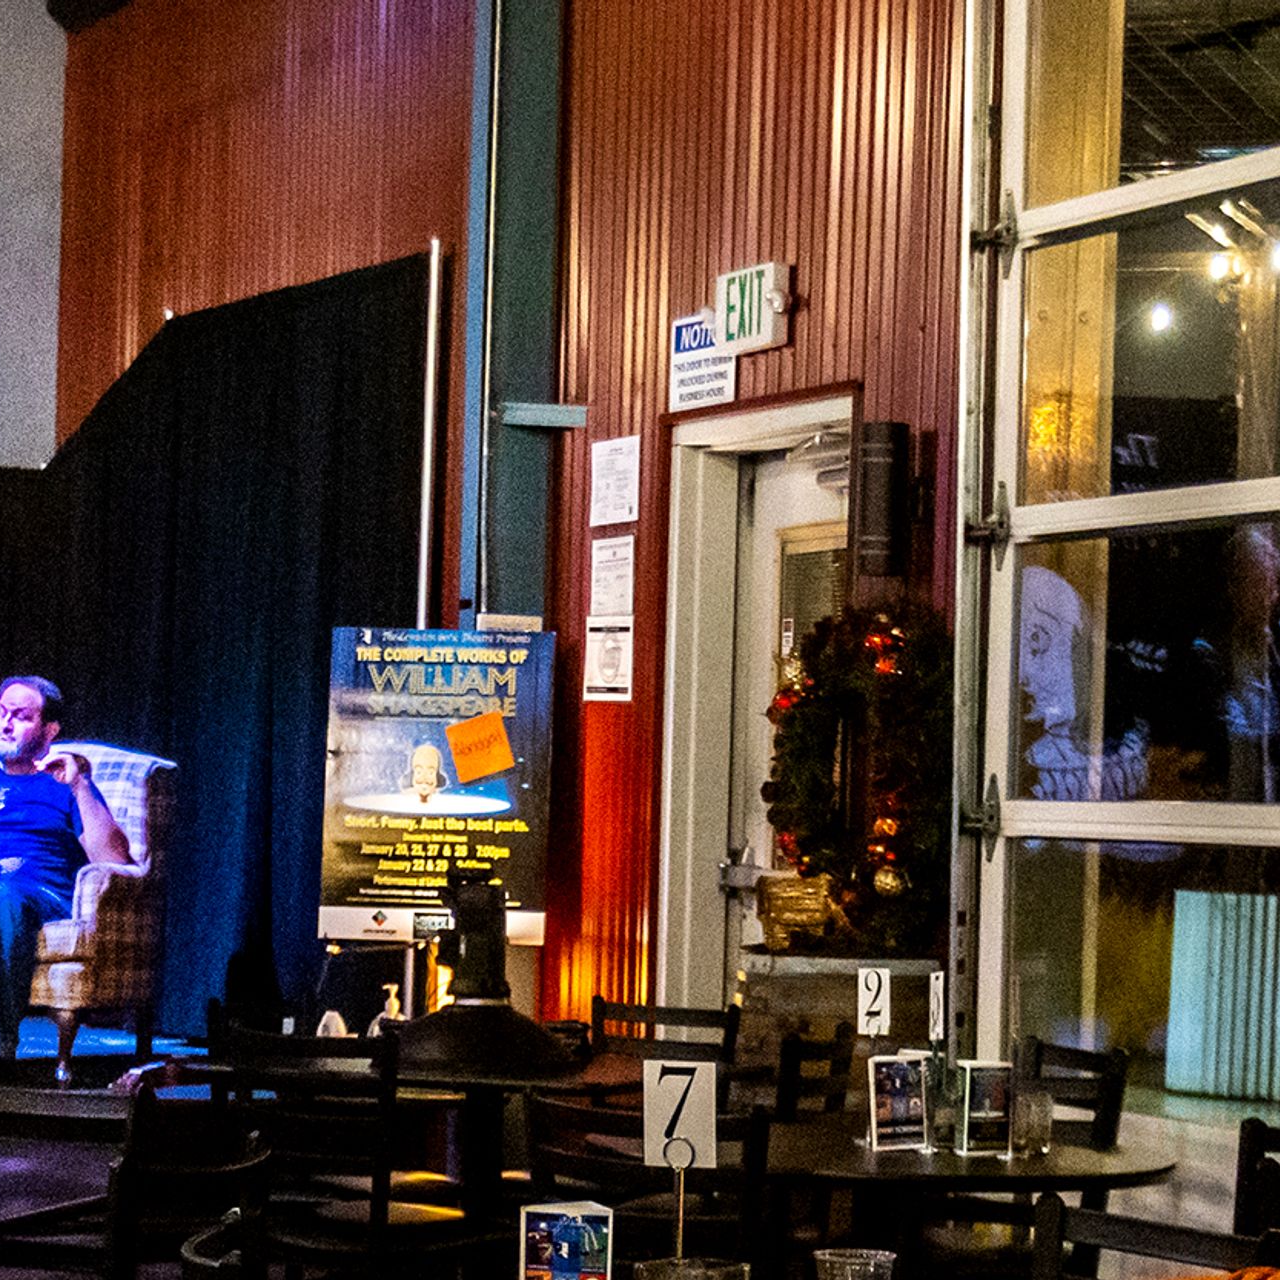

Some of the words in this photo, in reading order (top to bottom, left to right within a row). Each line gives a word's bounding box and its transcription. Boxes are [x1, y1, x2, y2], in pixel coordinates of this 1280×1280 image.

[725, 269, 765, 343] EXIT
[680, 323, 716, 351] NOTI
[356, 647, 381, 661] THE
[383, 647, 455, 663] COMPLETE
[458, 648, 507, 664] WORKS
[509, 649, 529, 665] OF
[368, 663, 516, 696] WILLIAM
[420, 817, 444, 830] Just
[446, 817, 465, 830] the
[467, 818, 493, 831] best
[361, 842, 394, 857] January
[378, 859, 412, 873] January
[864, 970, 883, 1016] 2
[656, 1064, 697, 1139] 7
